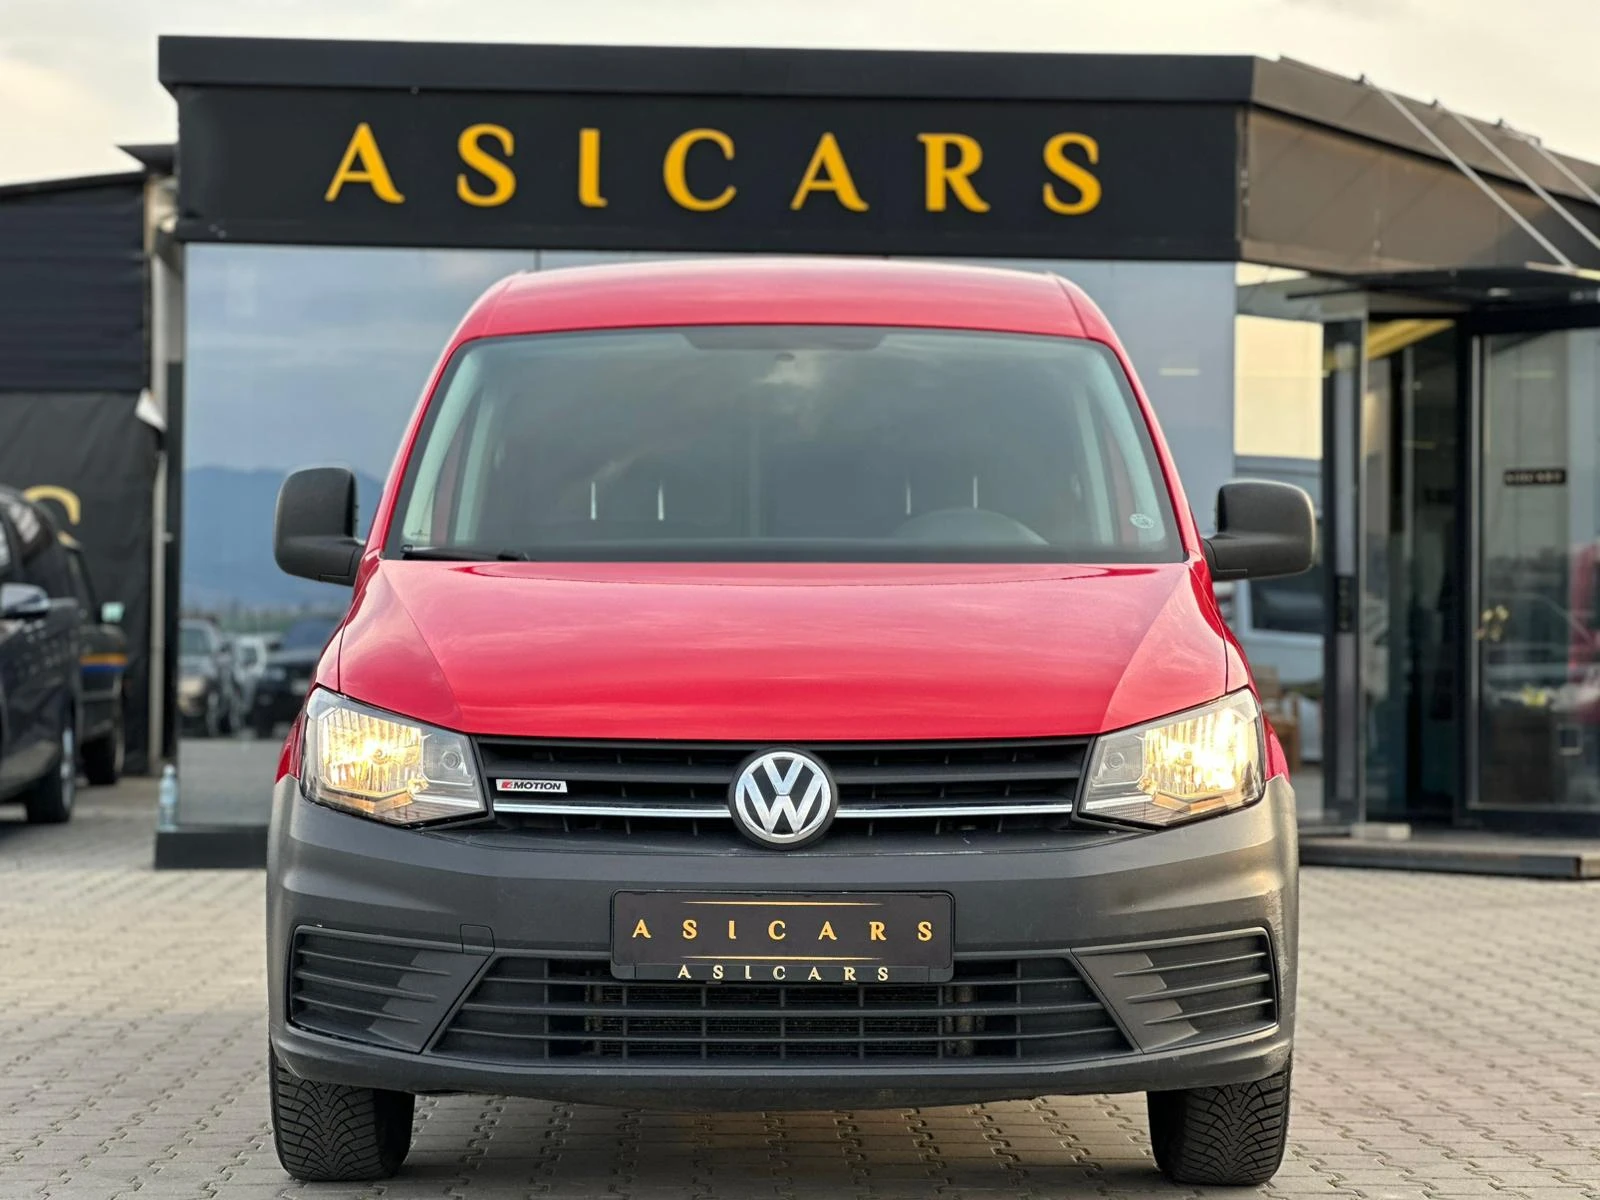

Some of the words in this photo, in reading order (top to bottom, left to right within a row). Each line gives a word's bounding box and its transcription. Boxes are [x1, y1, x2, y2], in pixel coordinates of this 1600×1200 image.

[325, 123, 1102, 215] ASICARS
[632, 919, 933, 942] ASICARS
[677, 964, 889, 982] ASICARS
